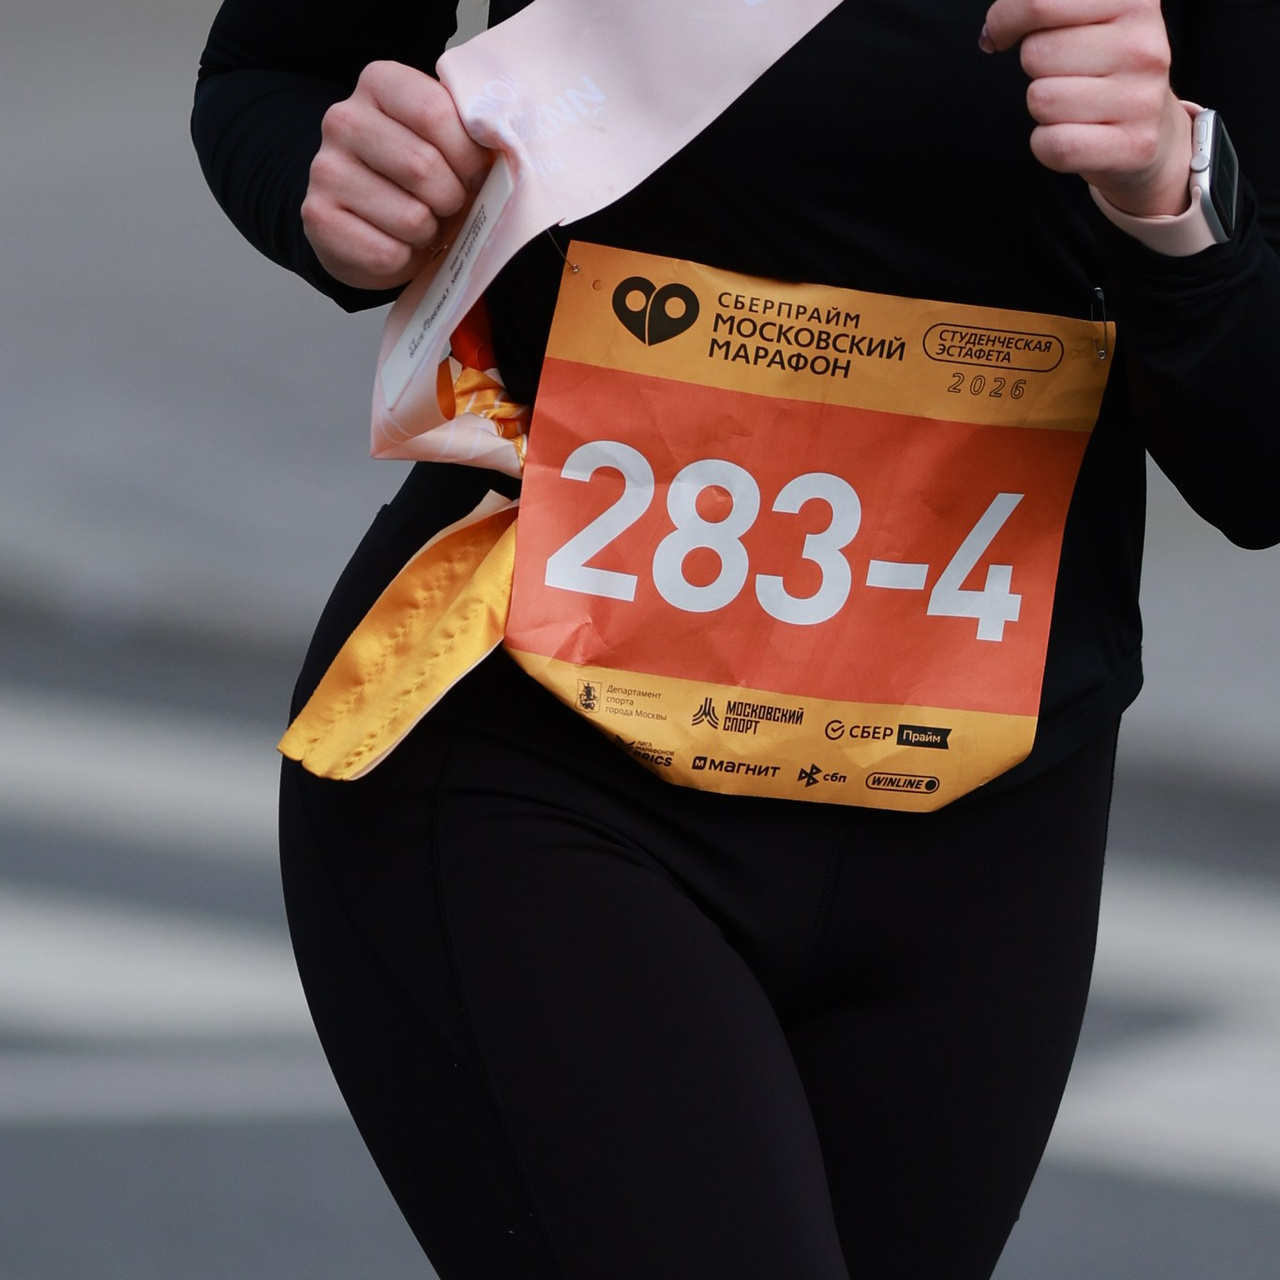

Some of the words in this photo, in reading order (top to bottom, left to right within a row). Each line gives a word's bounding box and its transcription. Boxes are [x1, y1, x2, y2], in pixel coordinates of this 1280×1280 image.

[717, 291, 861, 329] СБЕРПРАЙМ
[712, 312, 906, 361] МОСКОВСКИЙ
[938, 329, 1053, 353] СТУДЕНЧЕСКАЯ
[708, 337, 852, 379] МАРАФОН
[935, 343, 1012, 363] ЭСТАФЕТА
[947, 372, 1027, 400] 2026
[544, 439, 1025, 642] 283-4
[605, 696, 634, 706] спорта
[606, 684, 662, 699] Департамент
[605, 706, 633, 717] города
[635, 709, 668, 721] Москвы
[725, 700, 805, 726] МОСКОВСКИЙ
[722, 717, 760, 735] СПОРТ
[849, 724, 894, 740] СБЕР
[902, 729, 942, 744] Прайм
[823, 772, 847, 783] сбп
[870, 775, 924, 790] WINLINE
